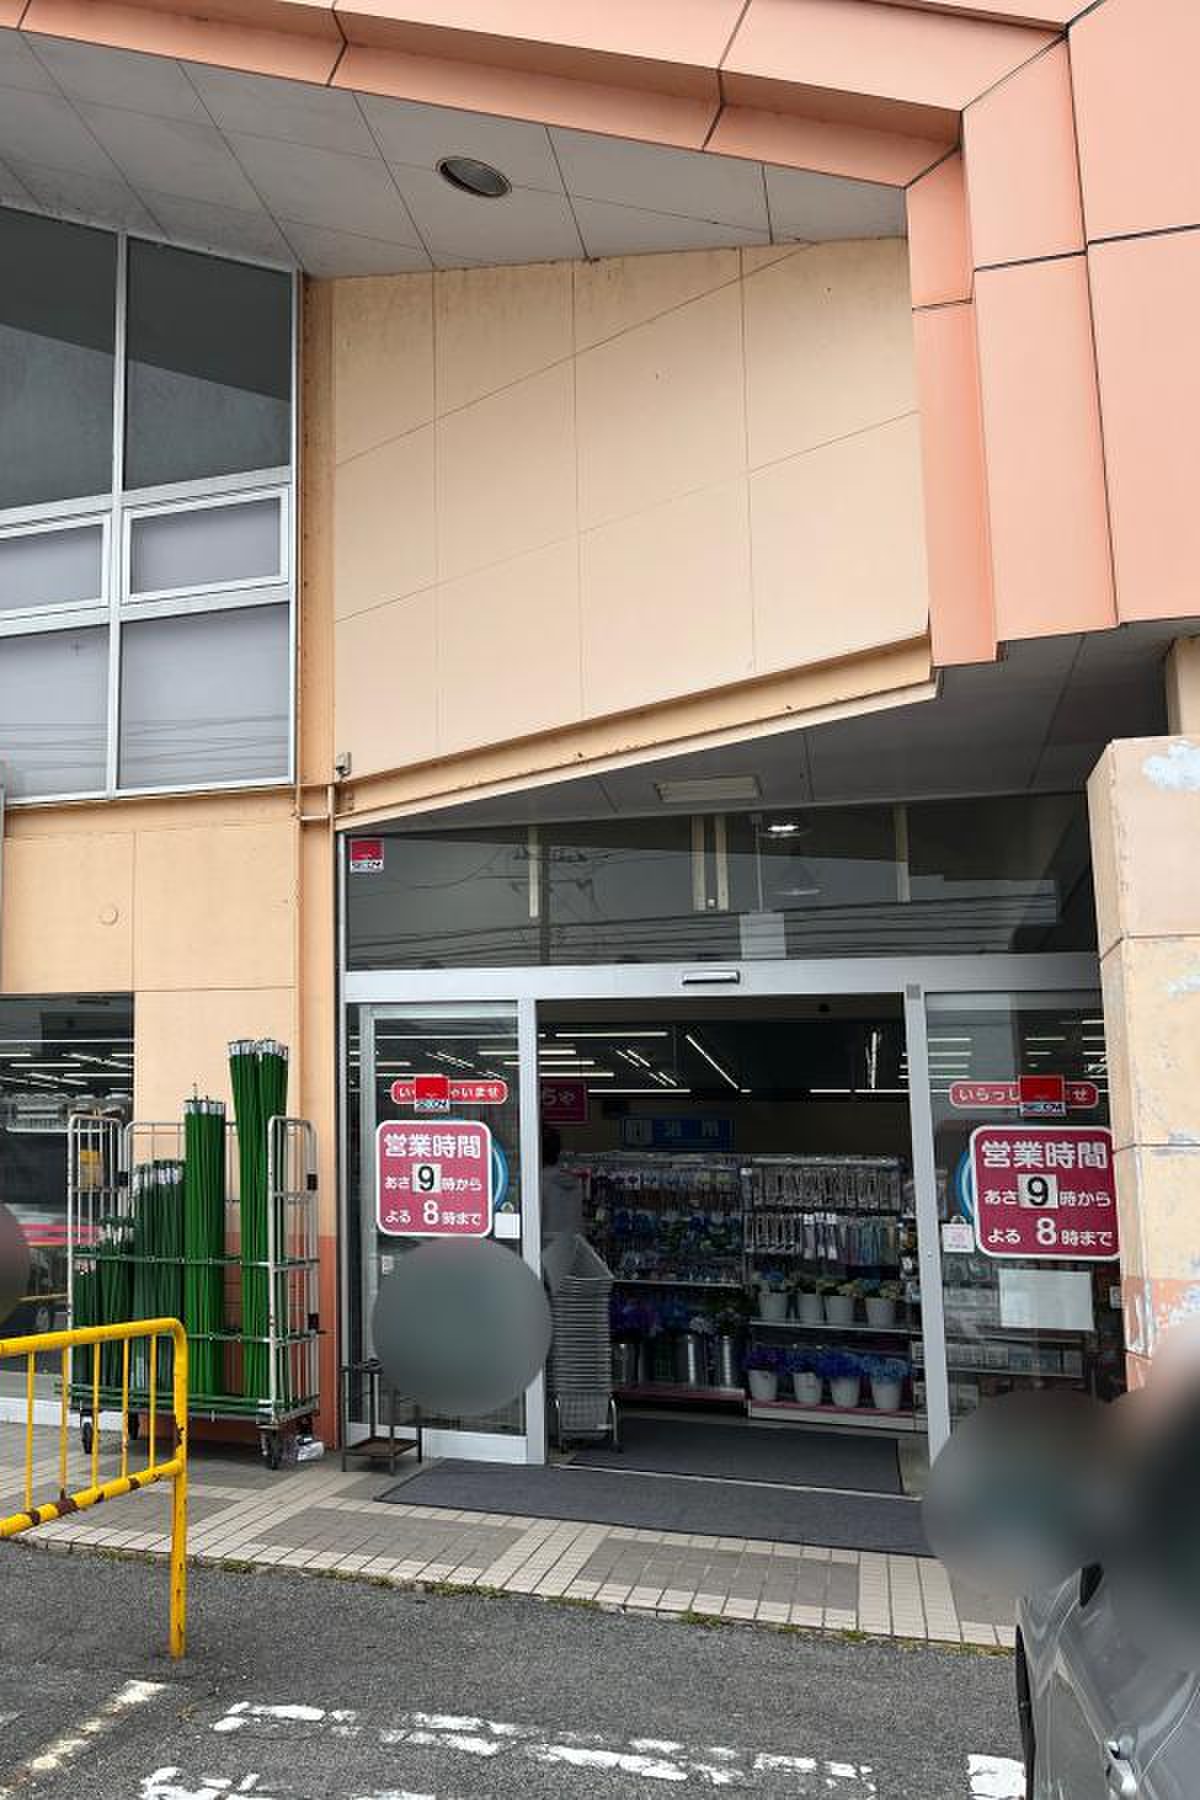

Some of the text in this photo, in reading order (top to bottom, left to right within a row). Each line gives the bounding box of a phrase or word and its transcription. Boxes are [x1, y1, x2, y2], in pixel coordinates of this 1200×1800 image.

[958, 1086, 1088, 1101] いらっしせ
[384, 1133, 481, 1158] 営業時間
[981, 1141, 1108, 1168] 営業時間
